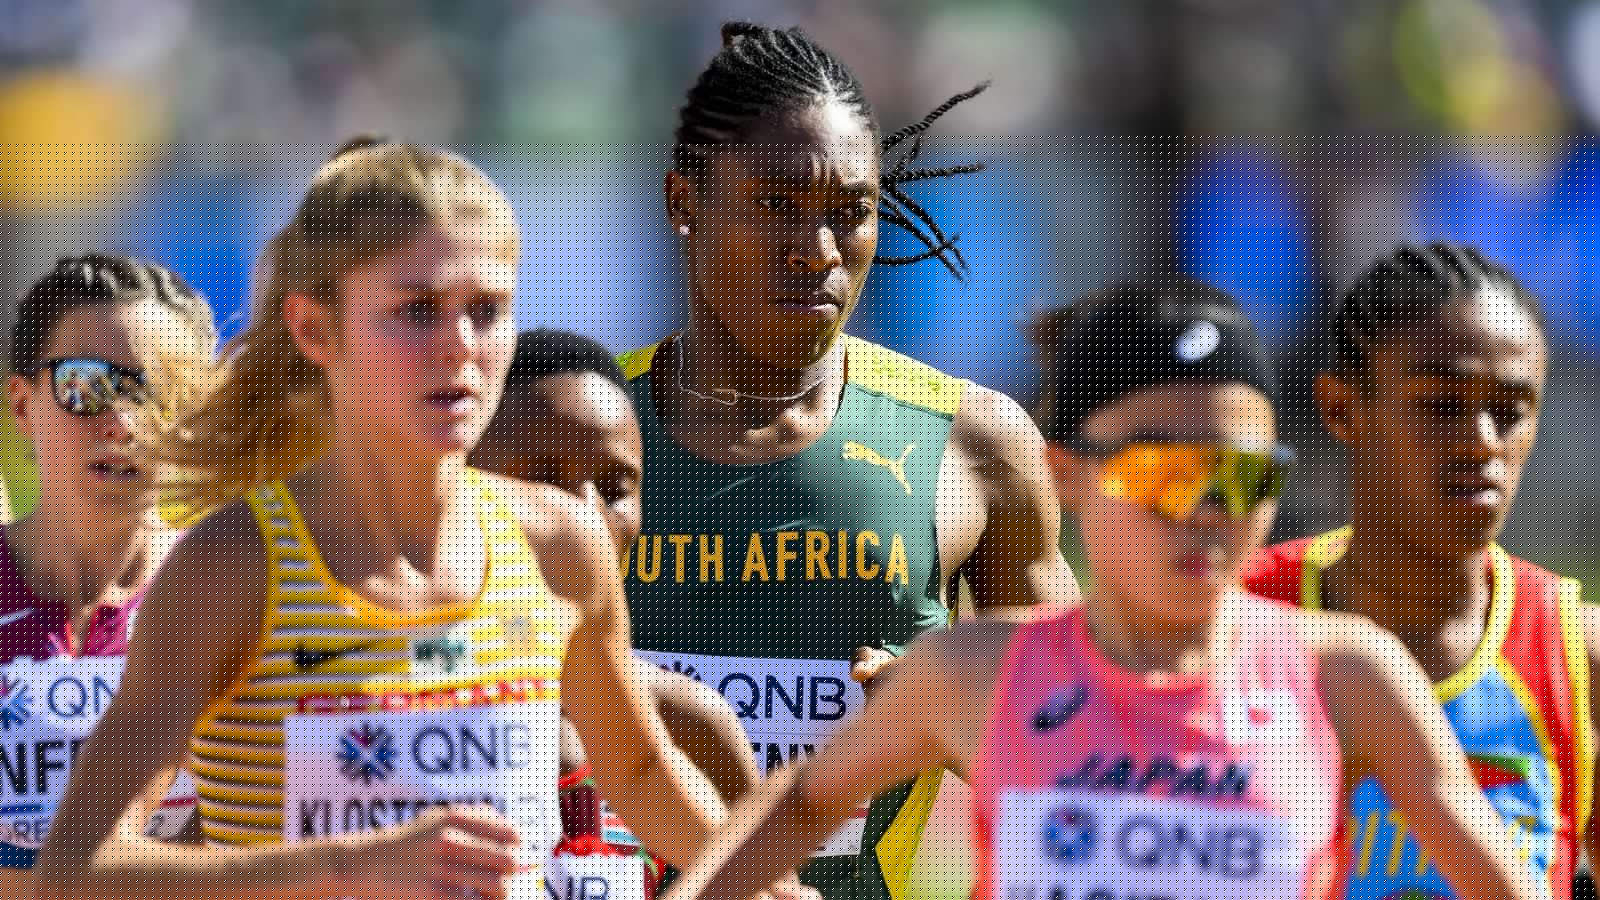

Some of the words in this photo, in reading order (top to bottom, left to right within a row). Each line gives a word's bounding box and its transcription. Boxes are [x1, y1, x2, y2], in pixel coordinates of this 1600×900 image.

[620, 533, 725, 584] UTH
[741, 529, 909, 585] AFRICA
[718, 672, 847, 721] QNB
[410, 723, 531, 774] QNB
[1115, 816, 1263, 881] QNB
